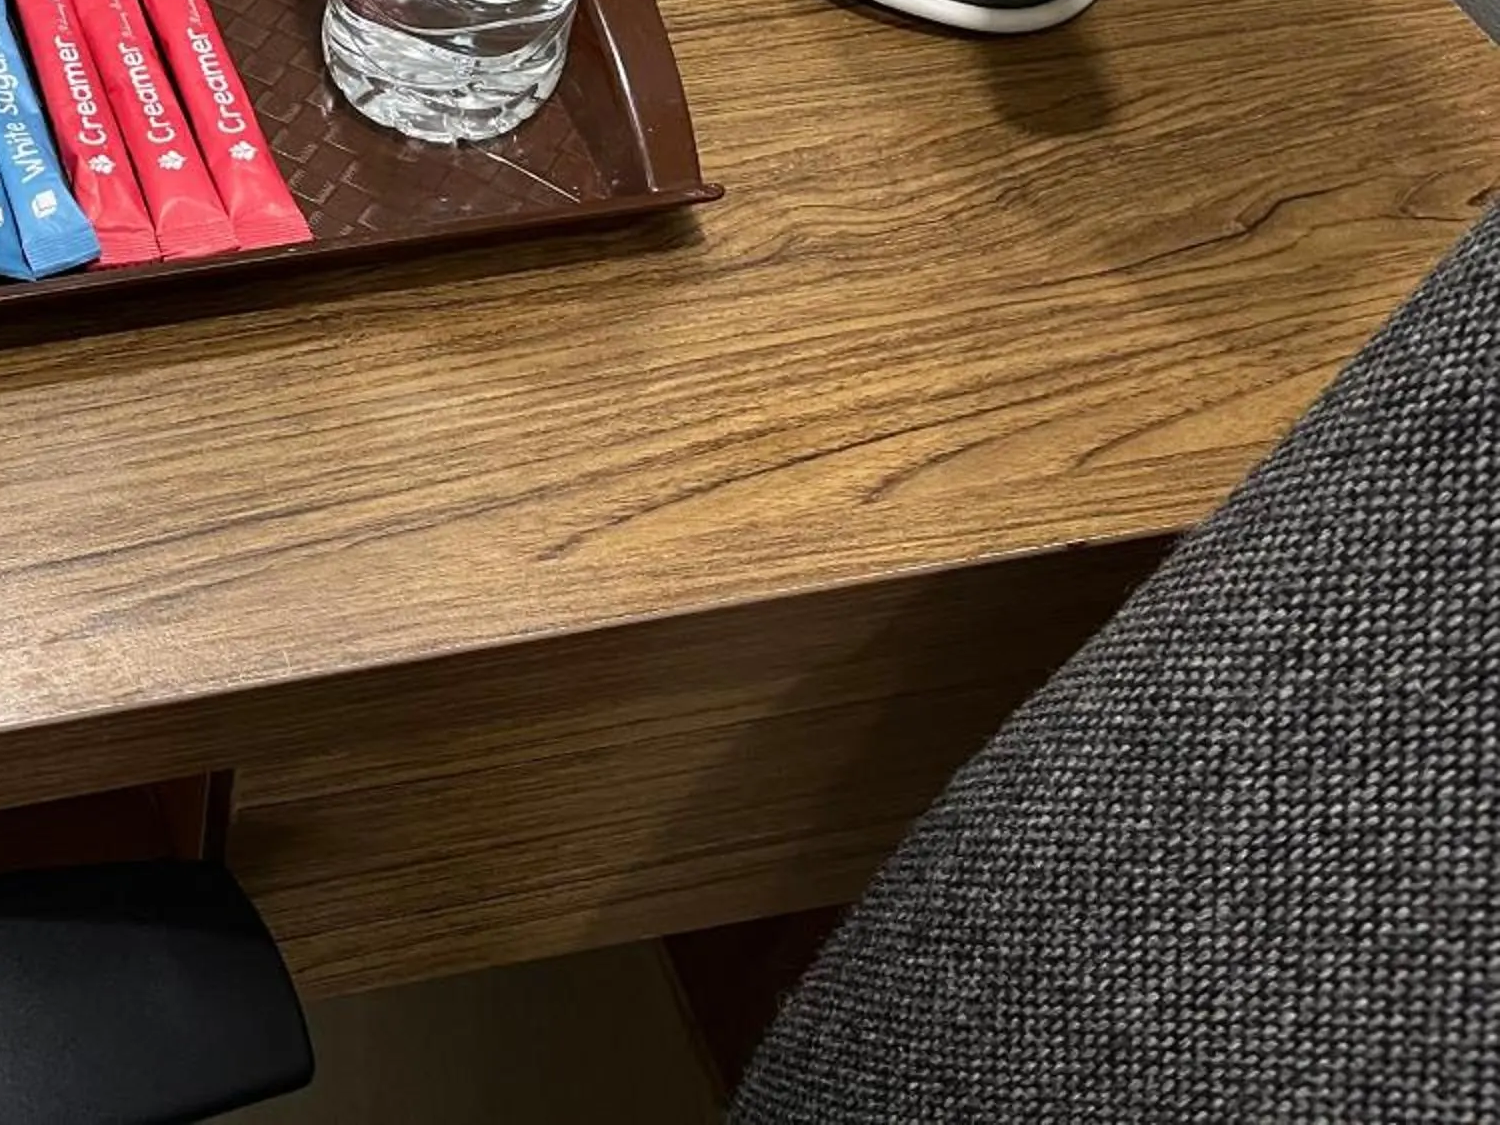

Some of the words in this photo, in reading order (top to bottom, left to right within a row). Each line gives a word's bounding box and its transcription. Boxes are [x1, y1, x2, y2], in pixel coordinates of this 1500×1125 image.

[54, 35, 108, 146] Creamer
[118, 42, 176, 144] Creamer
[187, 27, 246, 134] Creamer
[3, 122, 45, 184] White
